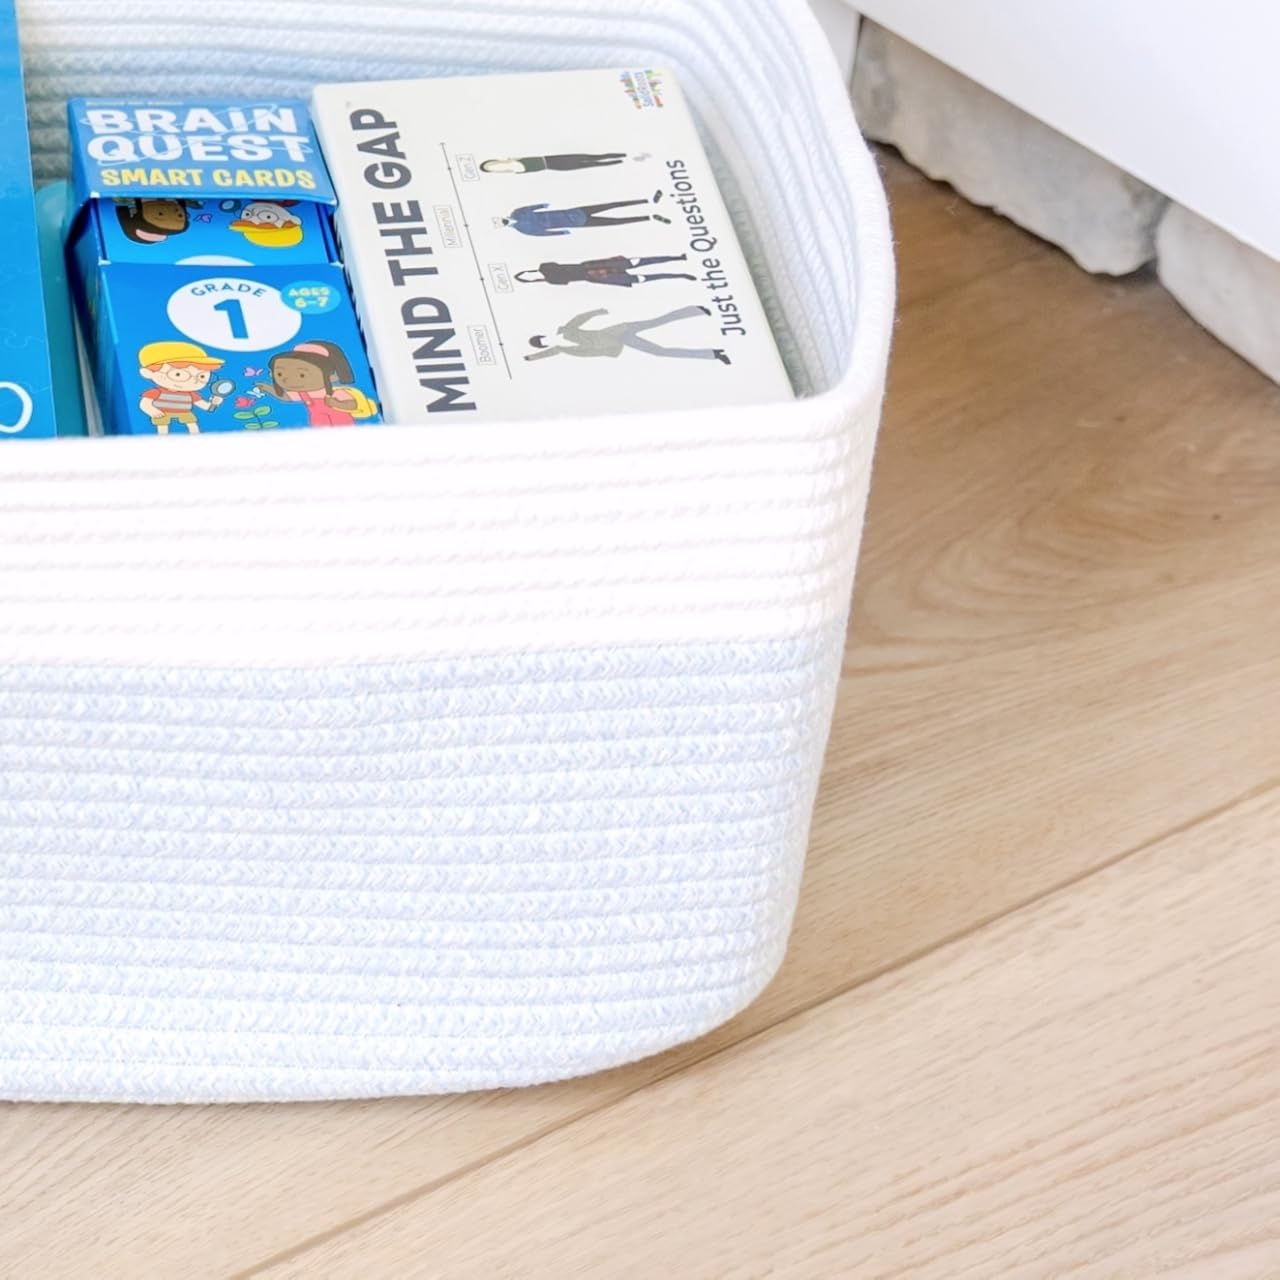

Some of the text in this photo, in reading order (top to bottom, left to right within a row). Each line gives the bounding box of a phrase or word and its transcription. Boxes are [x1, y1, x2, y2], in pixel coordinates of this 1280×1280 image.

[86, 107, 297, 134] BRAIN
[87, 134, 310, 163] QUEST
[100, 167, 316, 190] SMART CARDS
[349, 108, 477, 413] MIND THE GAP
[666, 159, 747, 336] Just the Questions
[191, 282, 267, 297] GRADE
[213, 298, 249, 339] 1
[473, 328, 492, 363] Boomer
